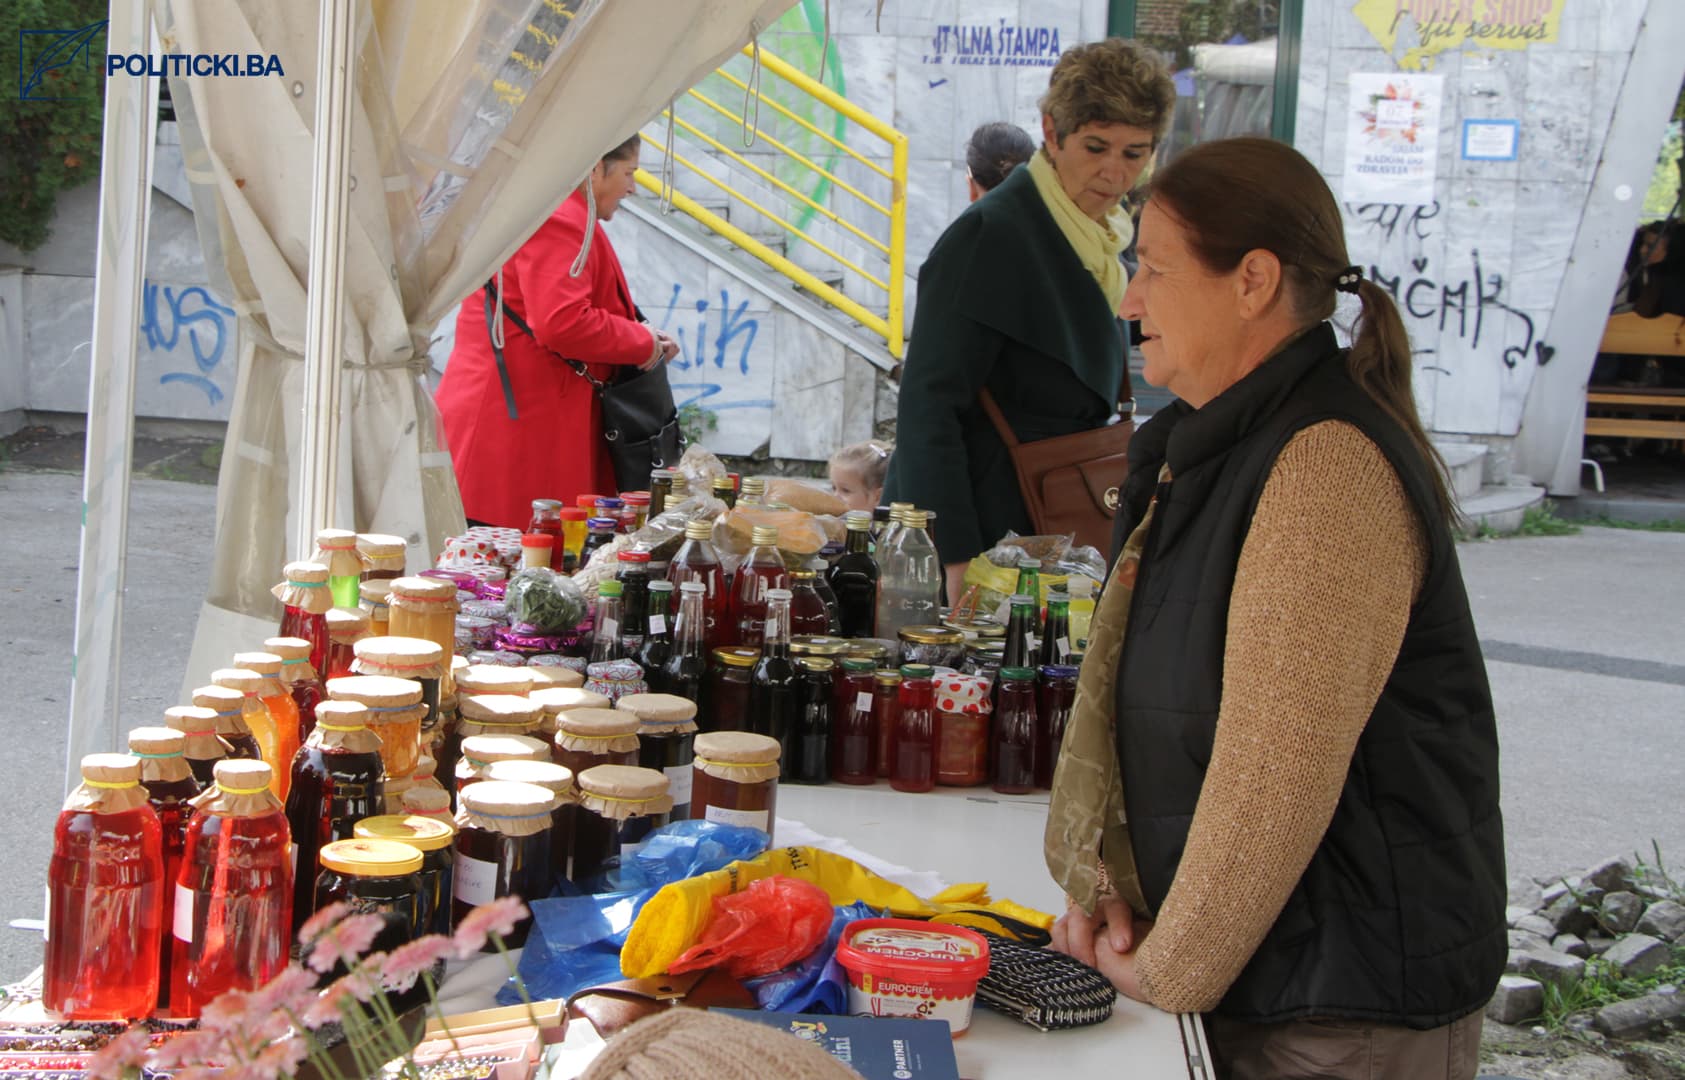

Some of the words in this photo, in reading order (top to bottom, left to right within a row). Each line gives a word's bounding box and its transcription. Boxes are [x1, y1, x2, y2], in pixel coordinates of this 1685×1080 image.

[1464, 19, 1549, 40] servis
[866, 946, 966, 963] EUROCREM
[878, 981, 935, 995] EUROCREM
[893, 1039, 907, 1070] PARTNER
